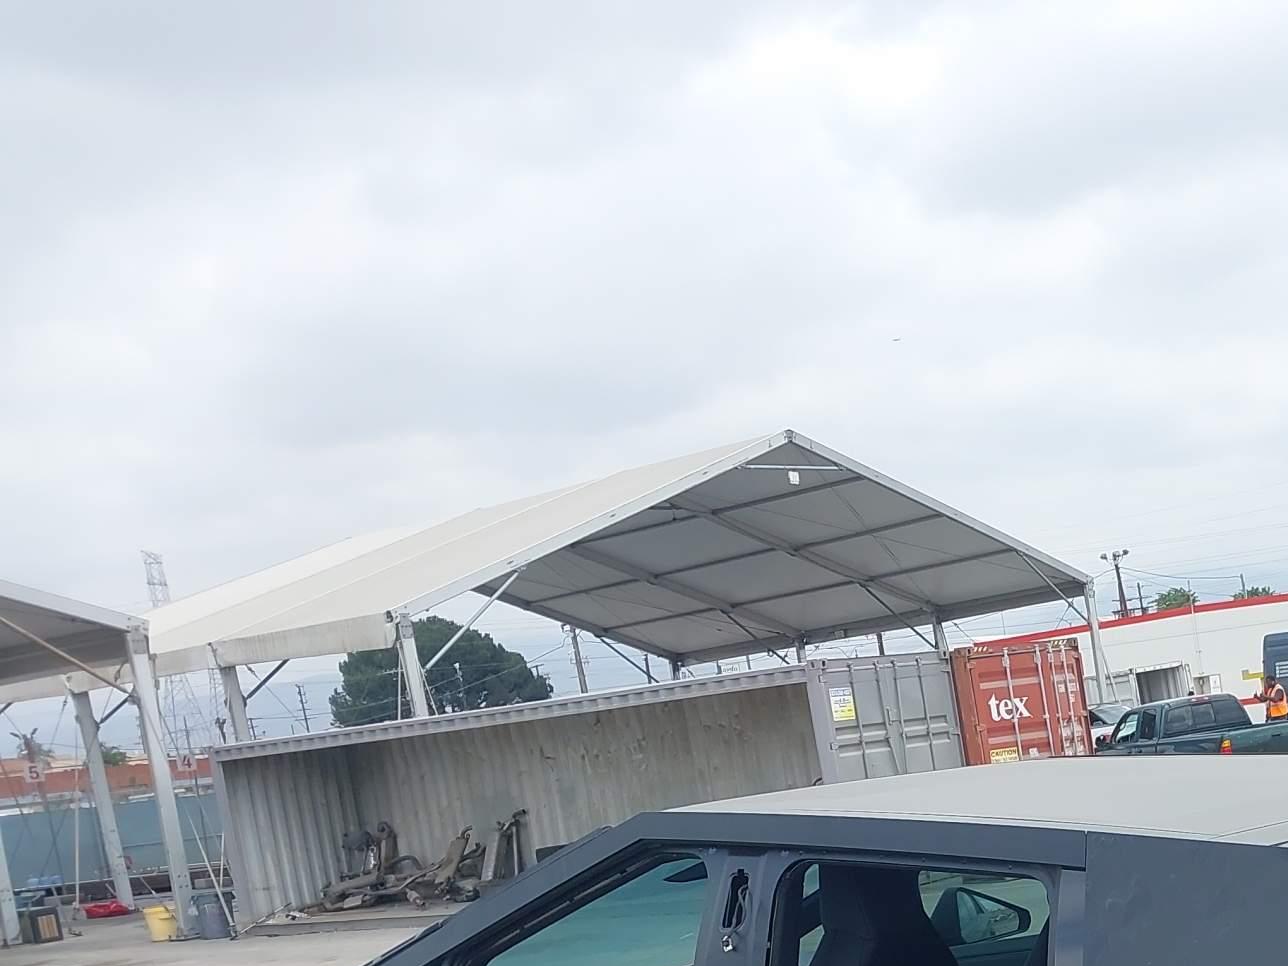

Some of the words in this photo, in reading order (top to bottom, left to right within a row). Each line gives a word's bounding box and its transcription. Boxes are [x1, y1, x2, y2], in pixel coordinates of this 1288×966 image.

[988, 693, 1033, 722] tex
[990, 748, 1017, 758] CAUTION
[181, 754, 193, 769] 4
[28, 765, 40, 780] 5
